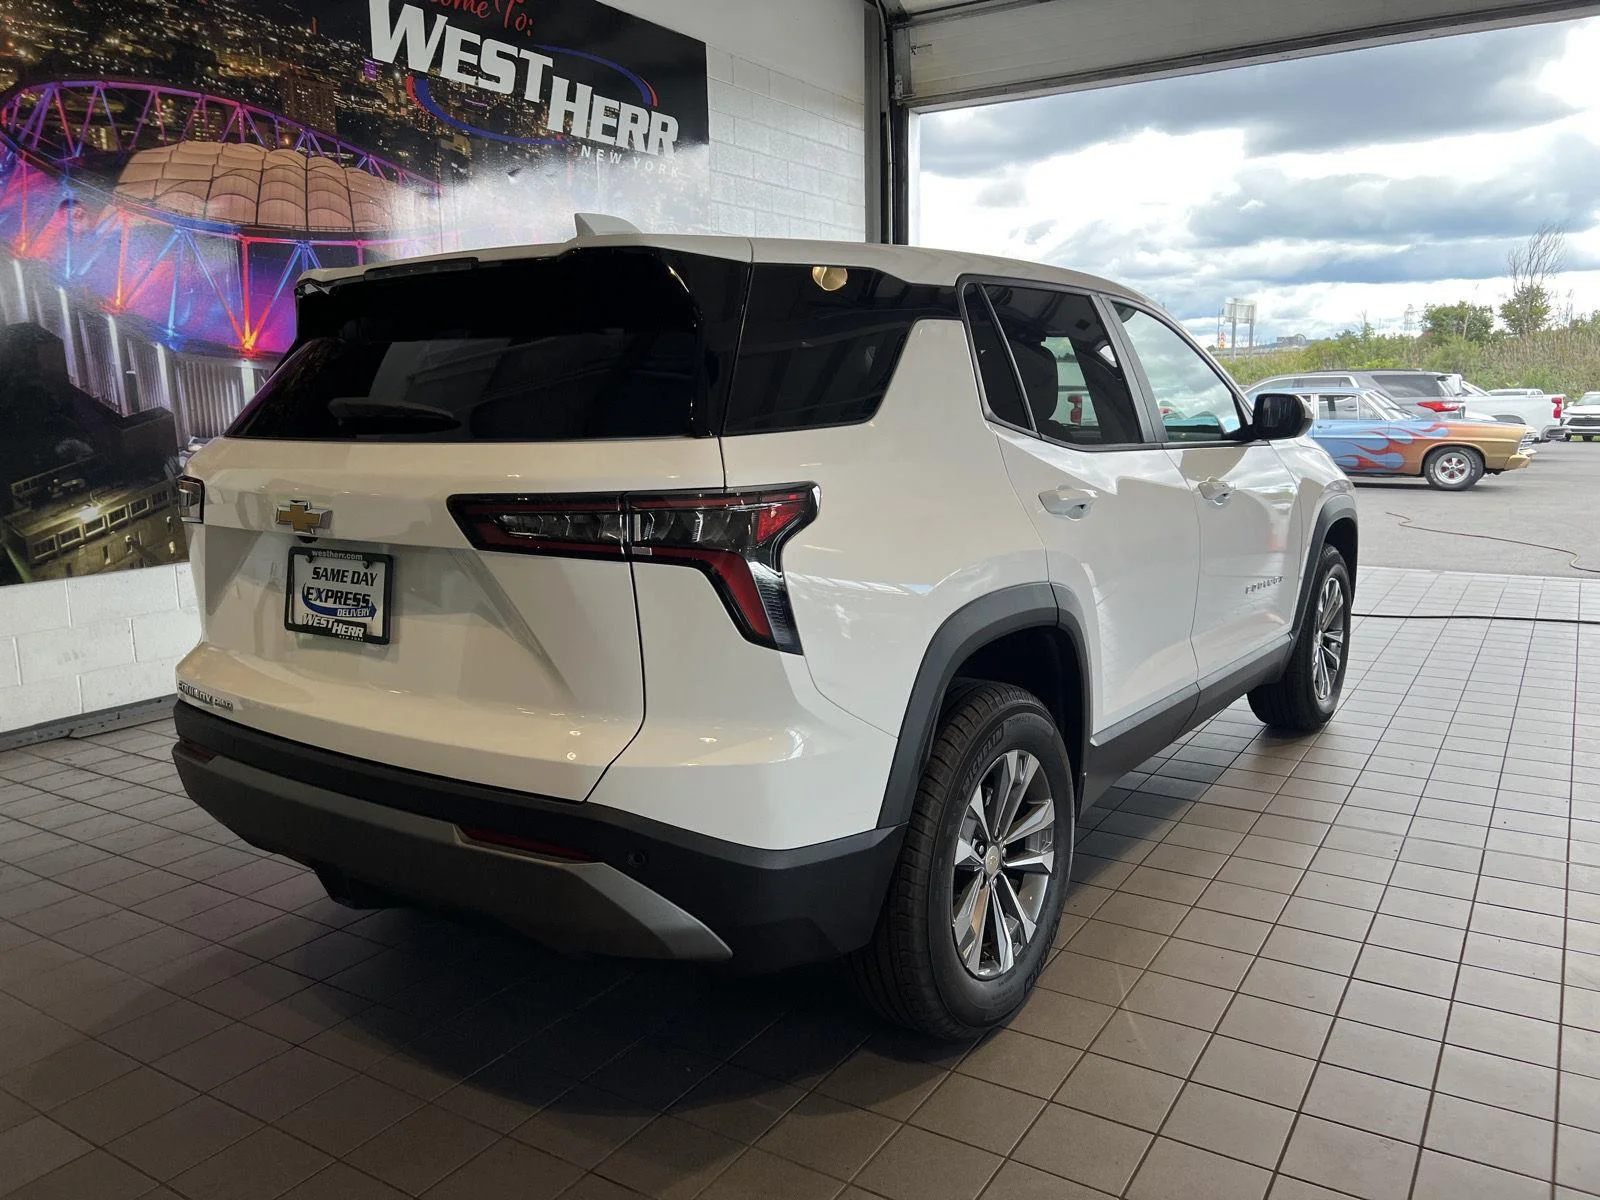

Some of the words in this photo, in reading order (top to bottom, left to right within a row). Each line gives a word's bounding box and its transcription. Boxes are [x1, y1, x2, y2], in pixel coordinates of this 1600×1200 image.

[368, 0, 553, 103] WEST
[547, 75, 679, 159] HERR
[581, 144, 622, 165] NEW
[633, 156, 679, 178] YORK
[311, 550, 363, 561] westherr.com
[312, 566, 349, 583] SAME
[351, 570, 378, 587] DAY
[305, 586, 371, 608] EXPRESS
[337, 608, 371, 617] DELIVERY
[303, 613, 335, 629] WEST
[332, 622, 365, 638] HERR
